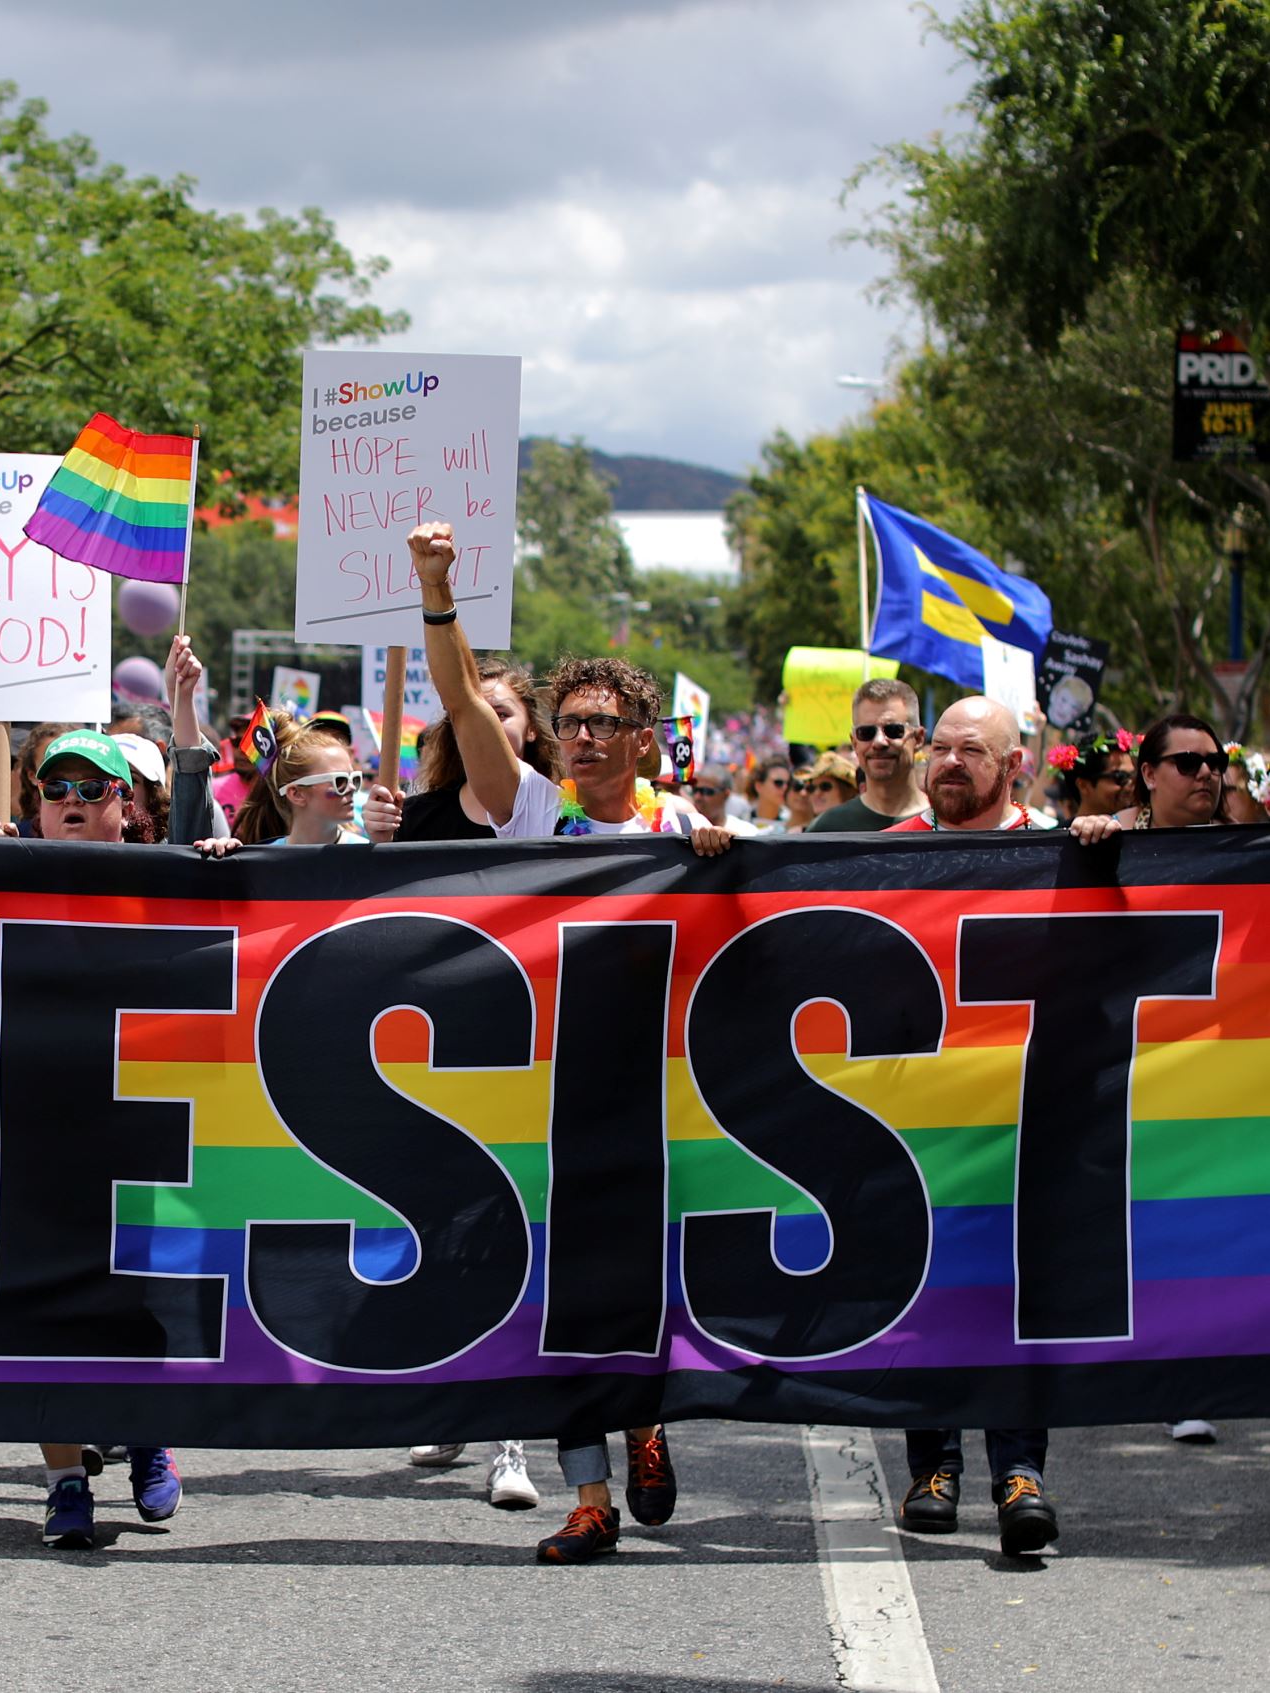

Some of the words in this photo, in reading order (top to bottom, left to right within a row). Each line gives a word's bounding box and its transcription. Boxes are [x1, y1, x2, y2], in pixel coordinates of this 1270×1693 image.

[1177, 352, 1267, 386] PRID
[313, 388, 318, 408] I
[324, 371, 440, 406] #ShowUp
[313, 404, 417, 435] because
[330, 436, 418, 475] HOPE
[443, 429, 490, 475] will
[323, 486, 445, 536] NEVER
[465, 482, 496, 518] be
